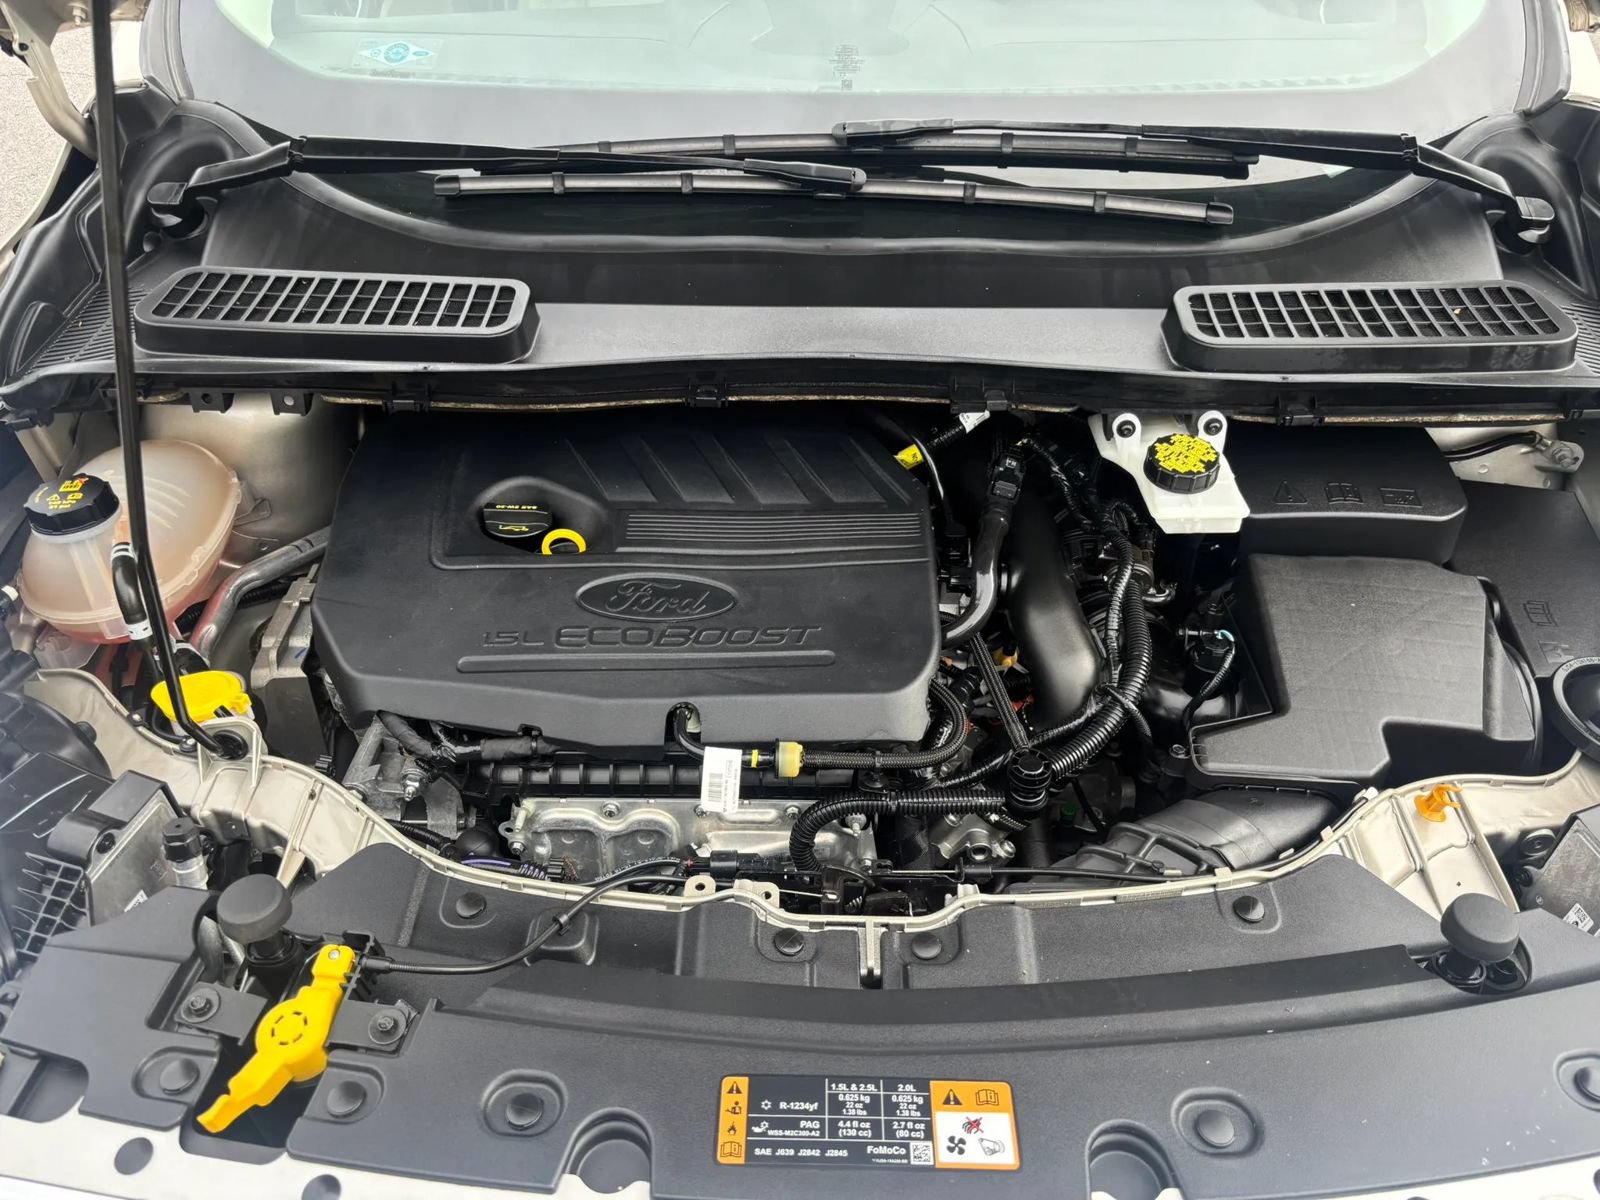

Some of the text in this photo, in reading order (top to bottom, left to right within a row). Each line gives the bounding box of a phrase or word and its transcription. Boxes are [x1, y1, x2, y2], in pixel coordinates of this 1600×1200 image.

[605, 580, 710, 615] Ford
[830, 1083, 878, 1092] 1.5L & 2.5L
[897, 1084, 917, 1092] 2.0L
[860, 1094, 870, 1104] kg
[891, 1095, 924, 1105] 0.625 kg
[779, 1101, 819, 1112] R-1234yf
[799, 1120, 820, 1128] PAG
[837, 1120, 851, 1128] 4.4
[852, 1120, 859, 1128] fl
[892, 1121, 905, 1129] 2.7
[838, 1128, 872, 1138] (130 cc)
[896, 1129, 925, 1139] (80 cc)
[754, 1148, 771, 1156] SAE
[775, 1148, 795, 1156] J639
[825, 1149, 848, 1157] J2845
[867, 1145, 906, 1155] FoMoCo
